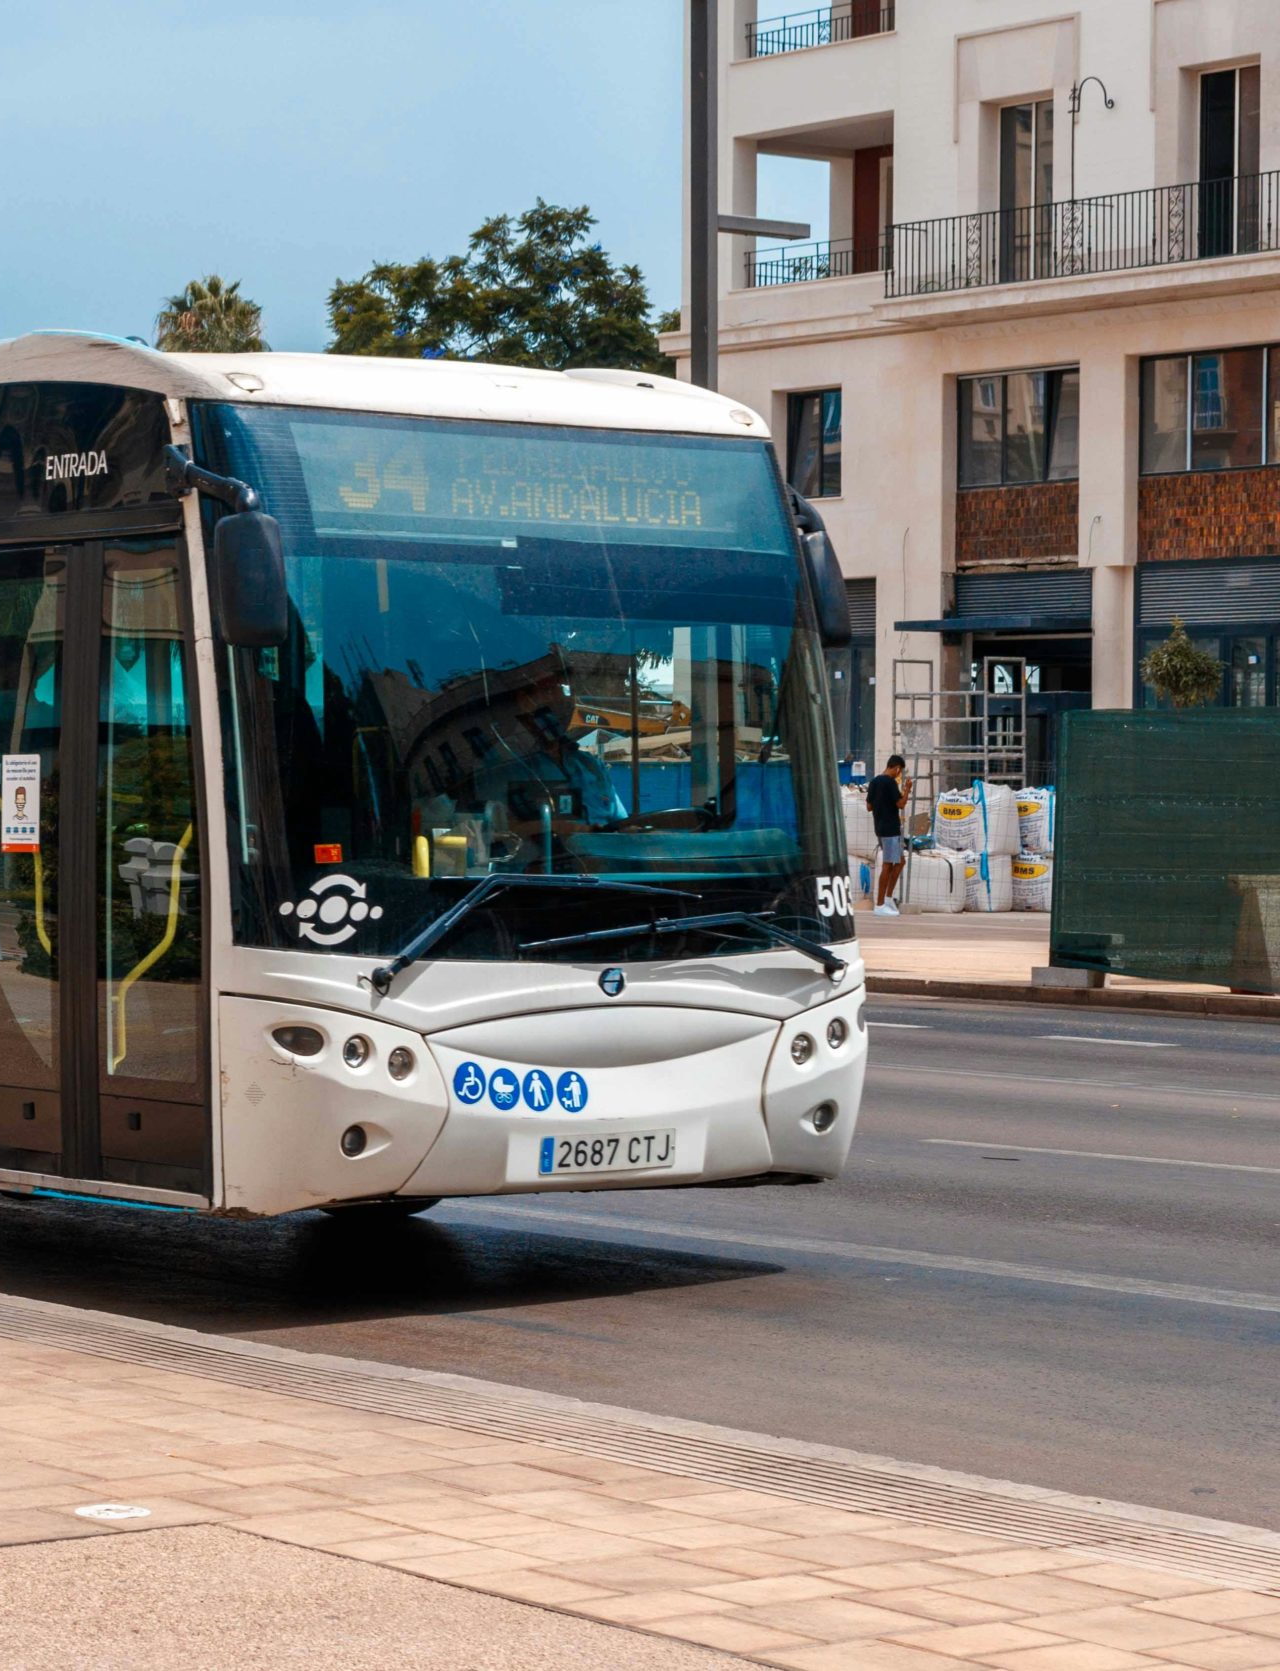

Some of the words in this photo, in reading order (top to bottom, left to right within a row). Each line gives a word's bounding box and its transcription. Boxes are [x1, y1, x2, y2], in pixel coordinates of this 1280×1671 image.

[45, 449, 109, 481] ENTRADA
[585, 714, 600, 724] CAT
[943, 807, 962, 816] BMS
[1014, 866, 1035, 875] BMS
[557, 1138, 620, 1168] 2687
[627, 1134, 670, 1163] CTJ
